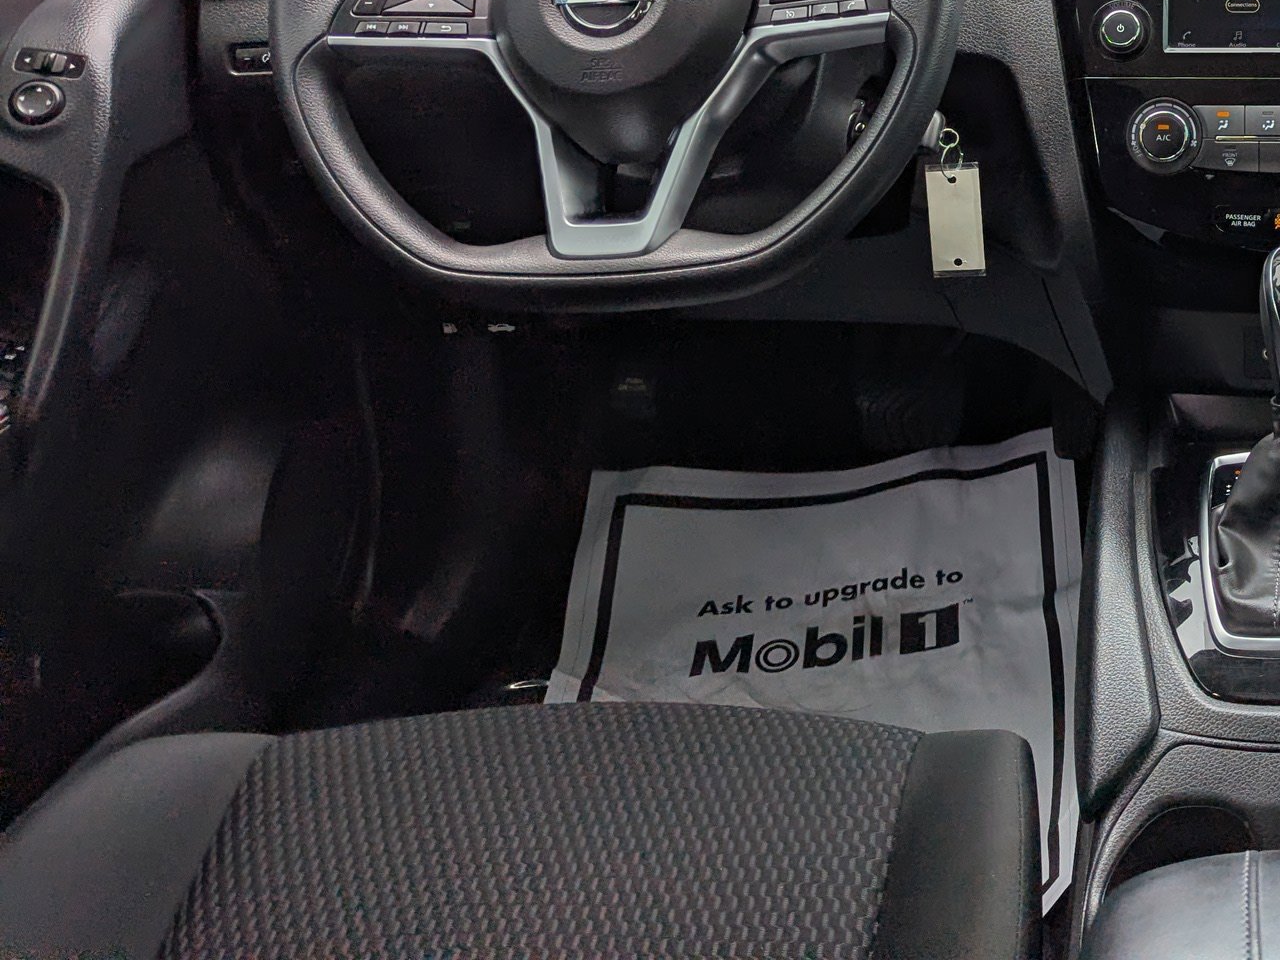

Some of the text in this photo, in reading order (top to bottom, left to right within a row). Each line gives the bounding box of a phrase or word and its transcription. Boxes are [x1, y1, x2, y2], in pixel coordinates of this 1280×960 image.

[1155, 133, 1172, 142] A/C
[1225, 213, 1262, 221] PASSENGER
[697, 567, 964, 617] Ask to upgrade to
[688, 614, 884, 678] Mobil
